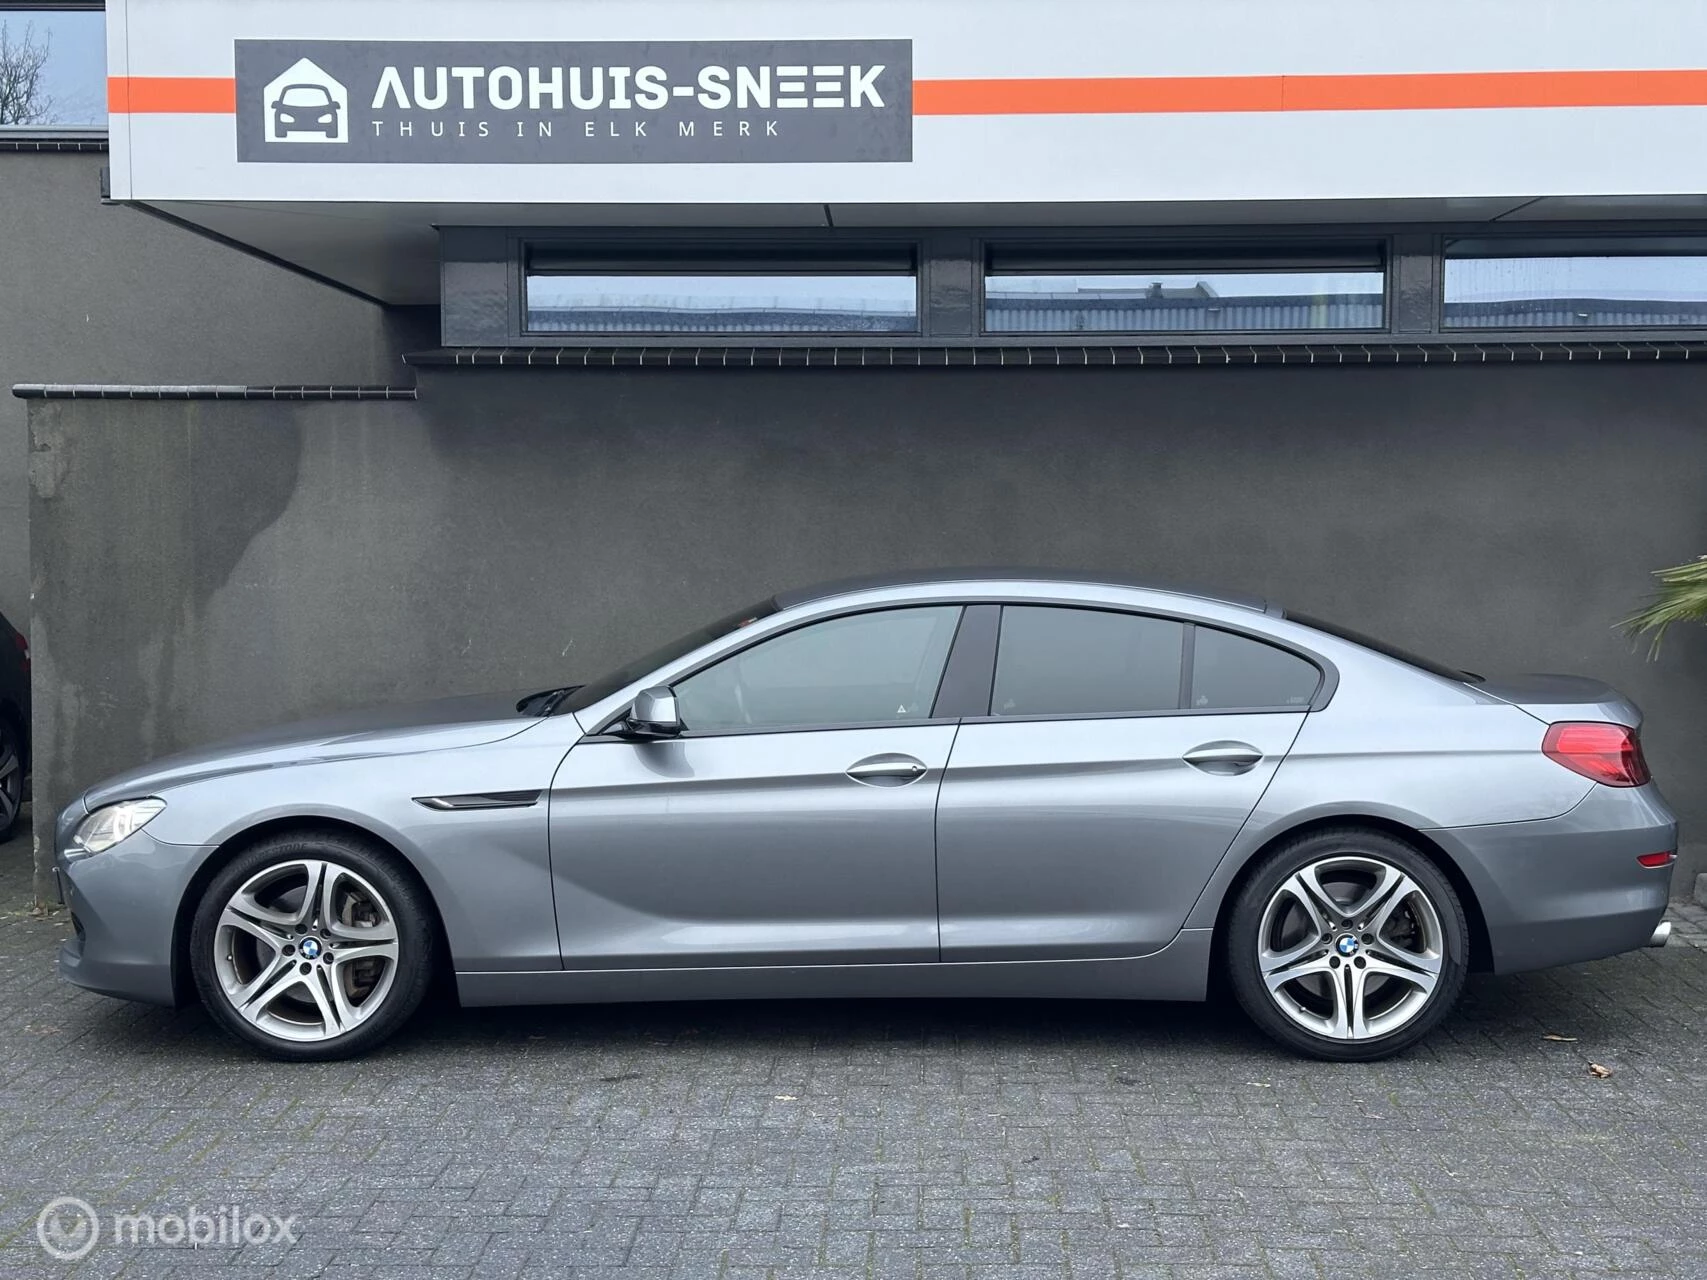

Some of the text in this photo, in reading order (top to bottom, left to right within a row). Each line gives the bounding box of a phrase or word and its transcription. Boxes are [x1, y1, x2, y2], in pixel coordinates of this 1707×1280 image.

[371, 65, 886, 111] AUTOHUIS-SNEEK
[372, 120, 778, 138] THUIS IN ELK MERK
